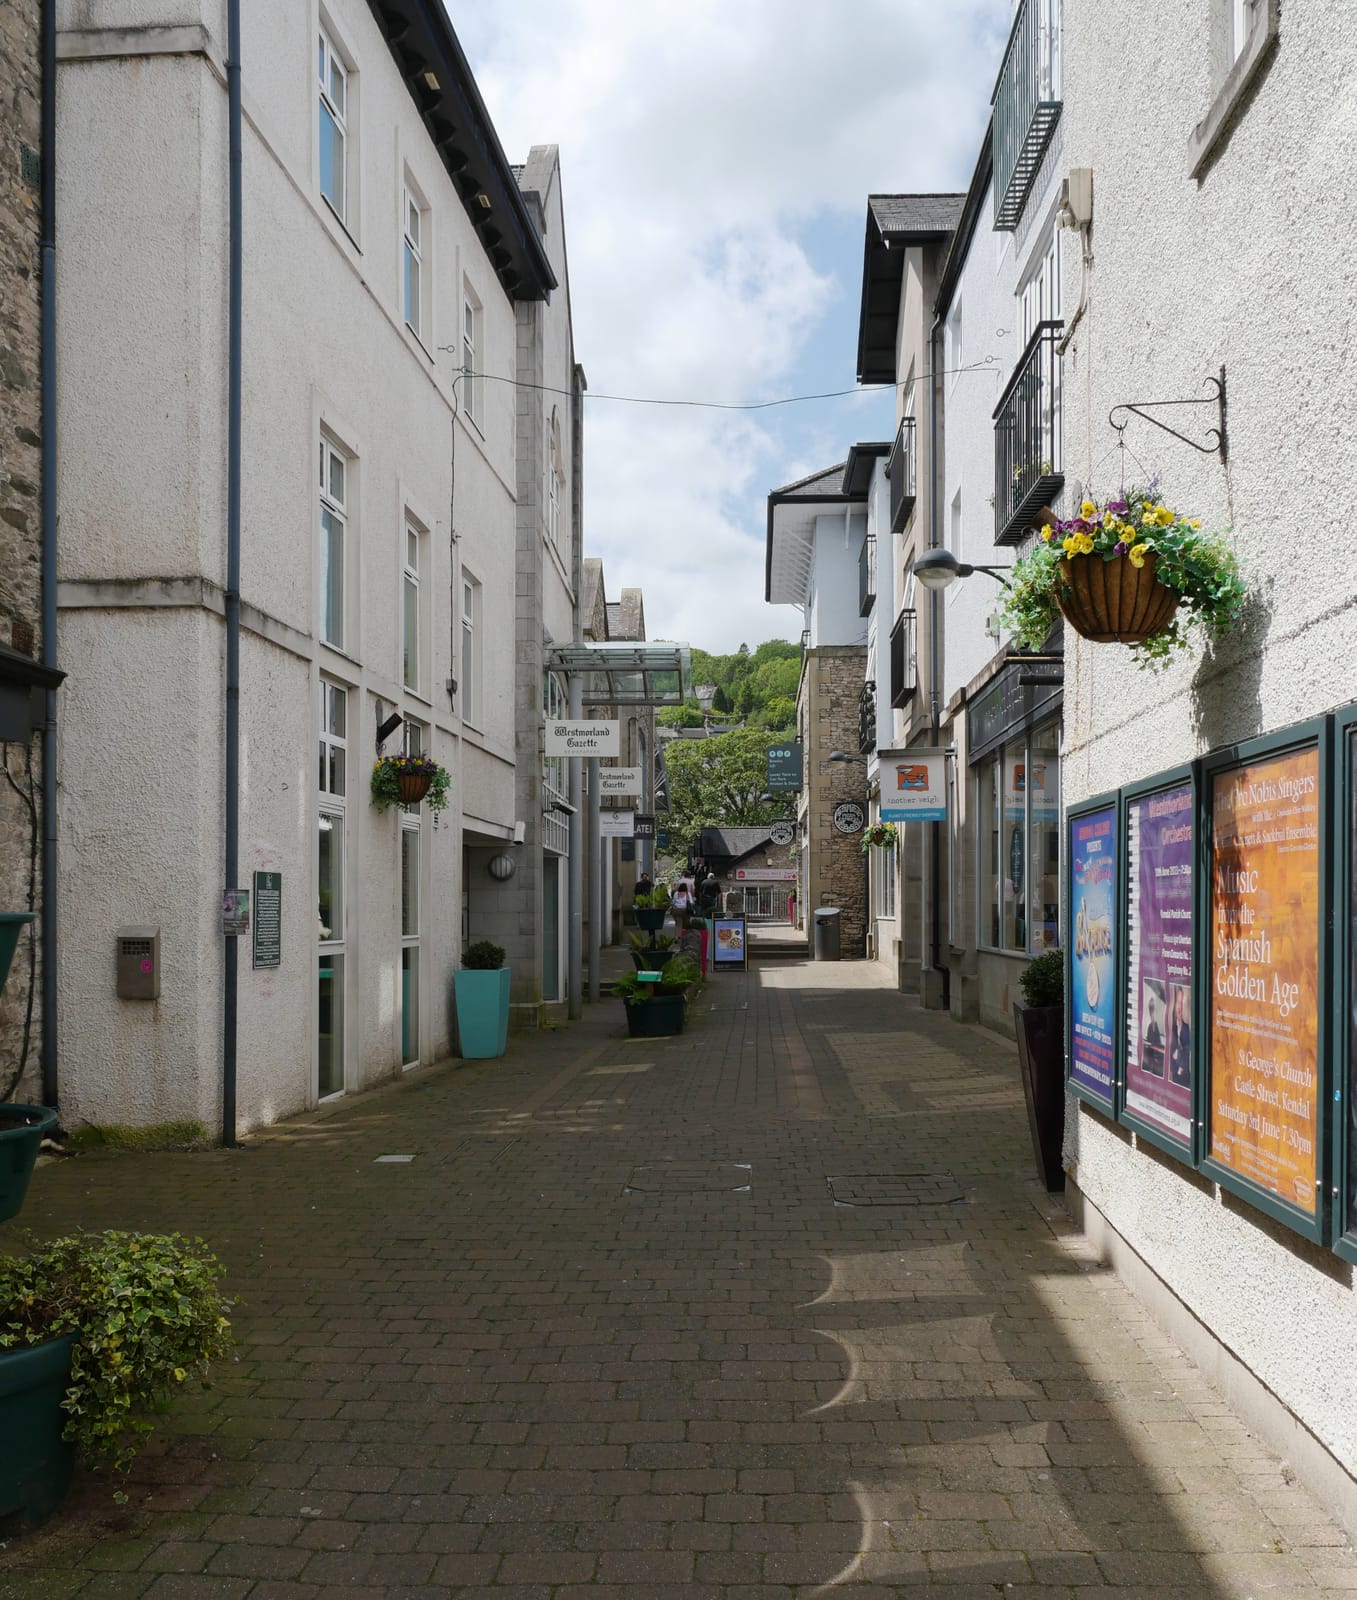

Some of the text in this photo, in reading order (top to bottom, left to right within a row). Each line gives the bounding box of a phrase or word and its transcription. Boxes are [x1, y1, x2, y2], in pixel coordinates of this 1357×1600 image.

[554, 726, 610, 737] Westmorland
[566, 737, 598, 748] Gazette
[602, 781, 626, 789] Gazette
[1249, 780, 1276, 804] Nobis
[1278, 775, 1315, 803] Singers
[1217, 862, 1259, 894] Music
[1217, 902, 1255, 925] from the
[1217, 929, 1271, 969] Spanish
[1216, 965, 1299, 1017] Golden Age
[1246, 1051, 1279, 1079] George's
[1280, 1061, 1312, 1088] Church
[1234, 1075, 1255, 1098] Castle
[1282, 1091, 1311, 1120] Kendal
[1217, 1098, 1248, 1131] Saturday
[1248, 1110, 1260, 1132] 3rd
[1260, 1116, 1280, 1140] June
[1281, 1124, 1312, 1156] 7.30pm
